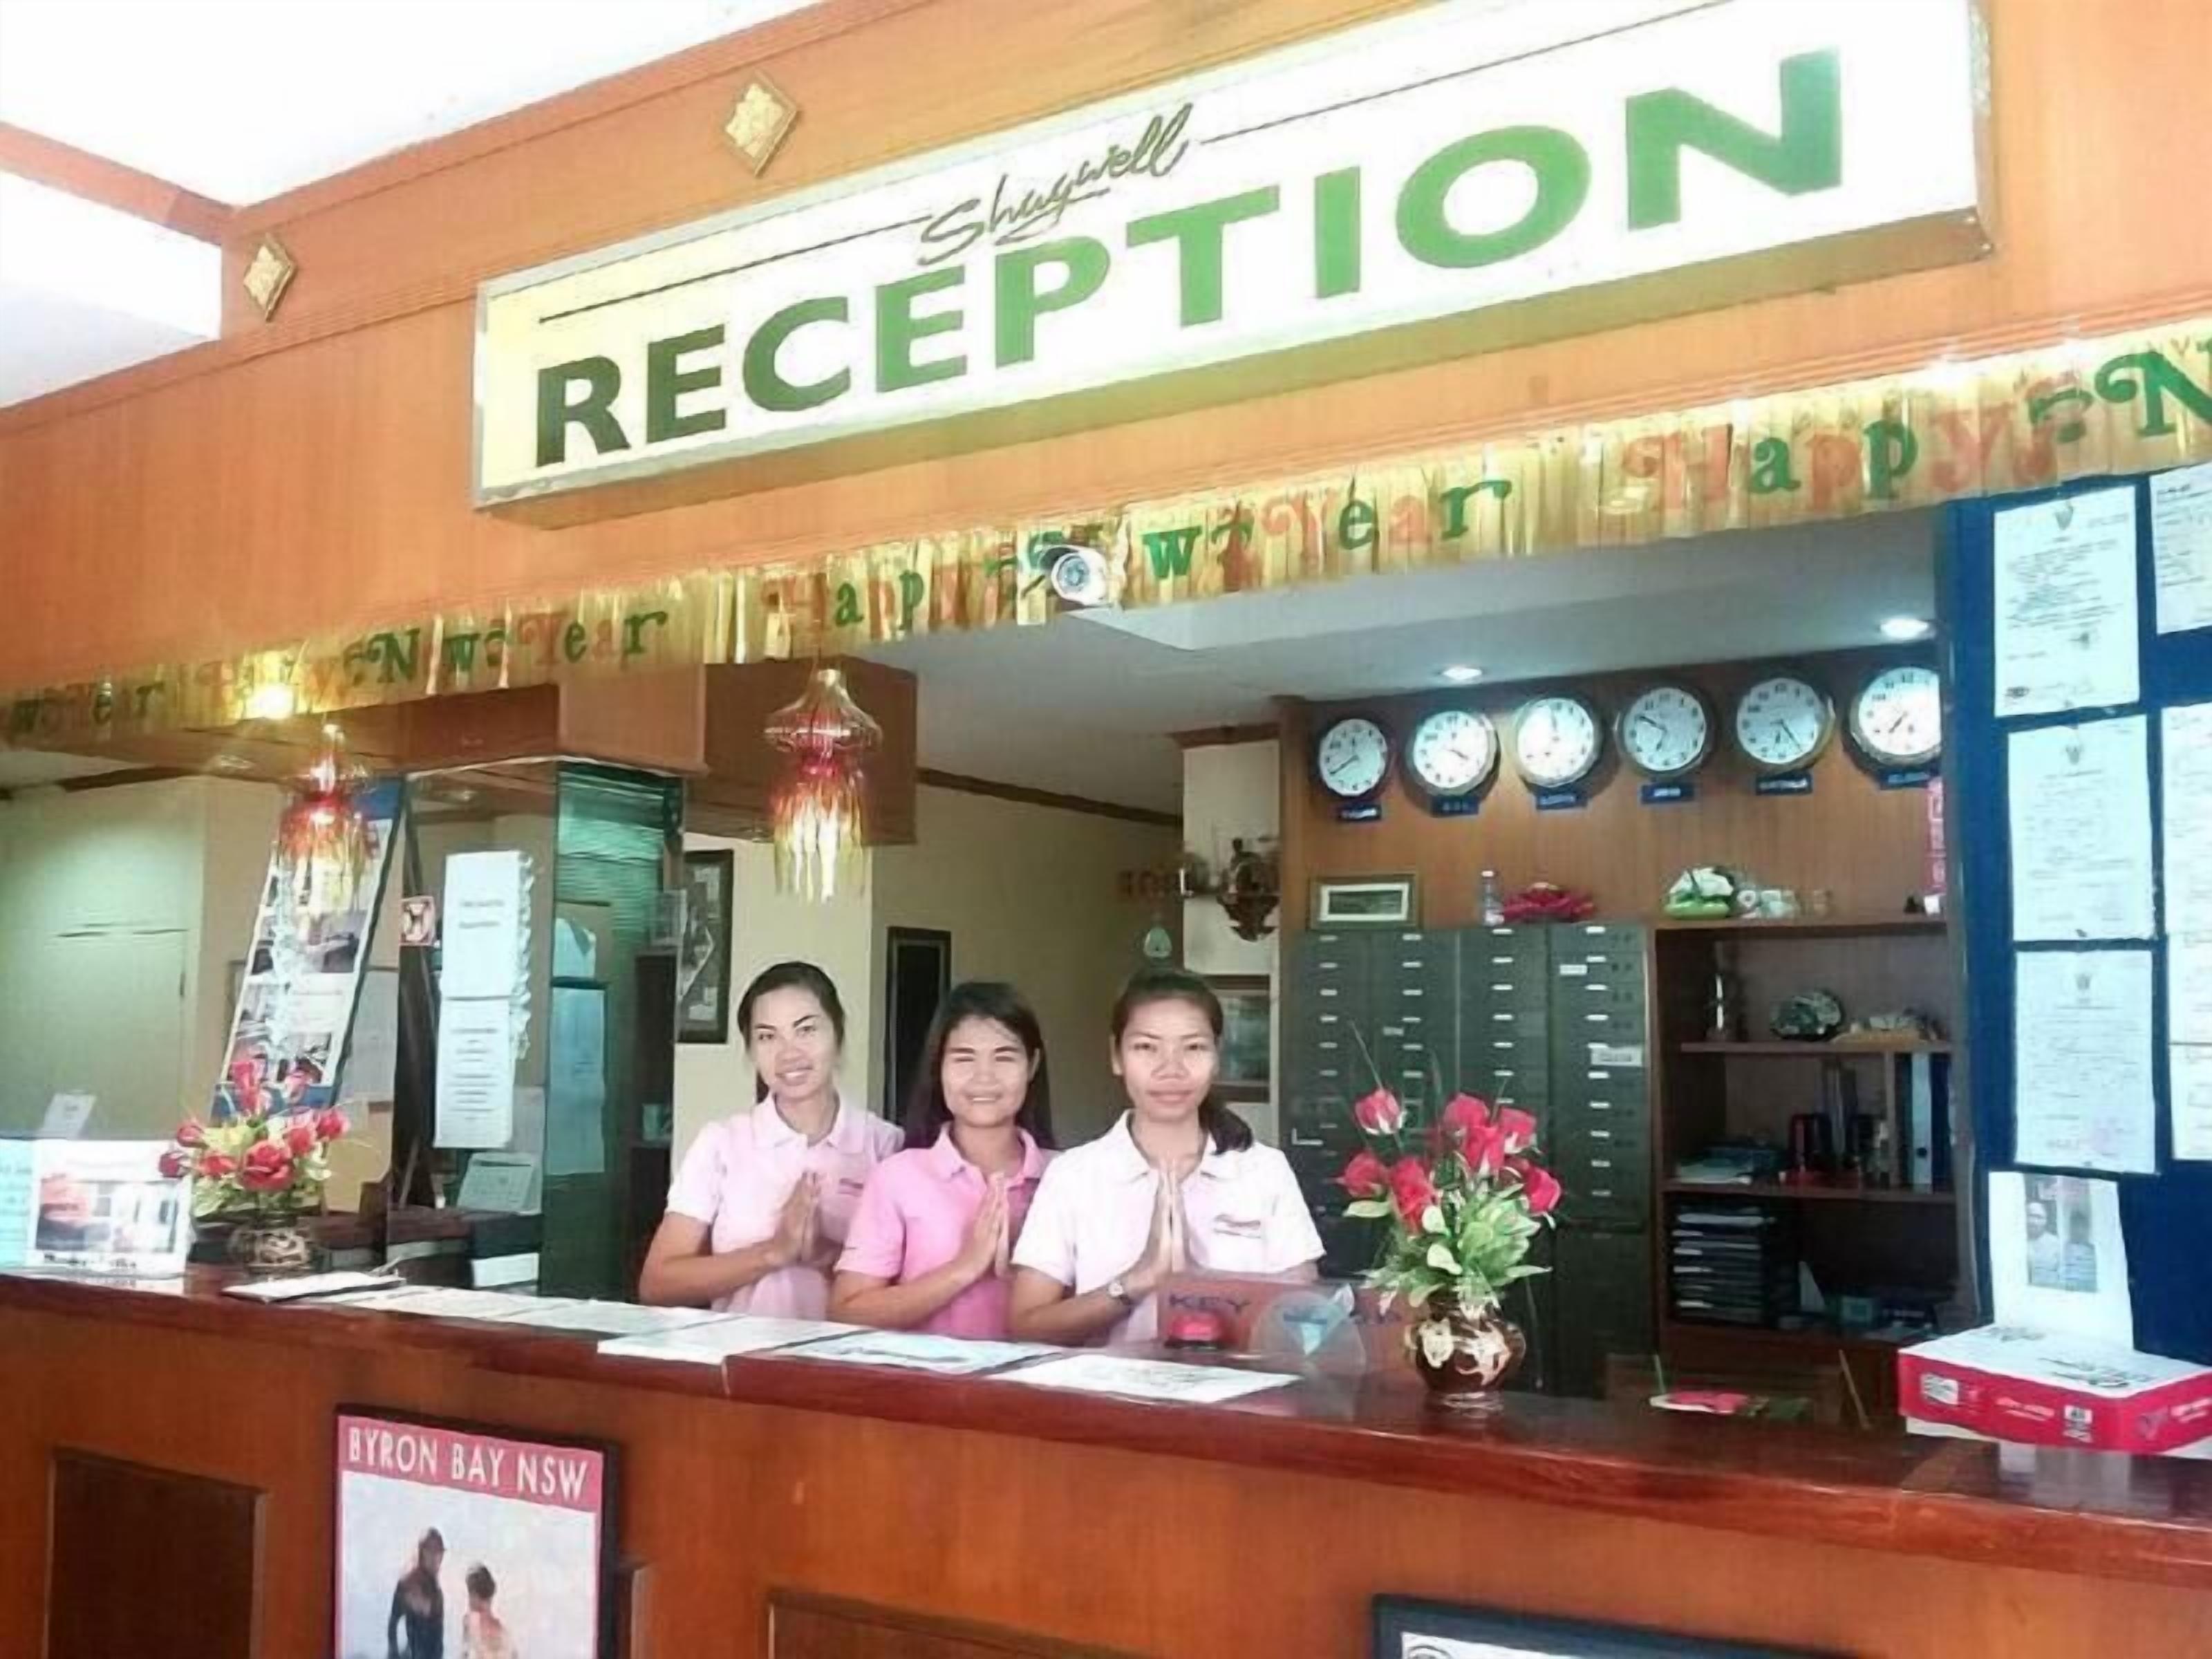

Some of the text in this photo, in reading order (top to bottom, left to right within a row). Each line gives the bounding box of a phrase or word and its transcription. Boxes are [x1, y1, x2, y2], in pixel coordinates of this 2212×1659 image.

[536, 46, 1841, 467] RECEPTION
[1621, 401, 2010, 512] Happy
[1262, 478, 1512, 567] Year
[349, 1426, 588, 1501] BYRON BAY NSW
